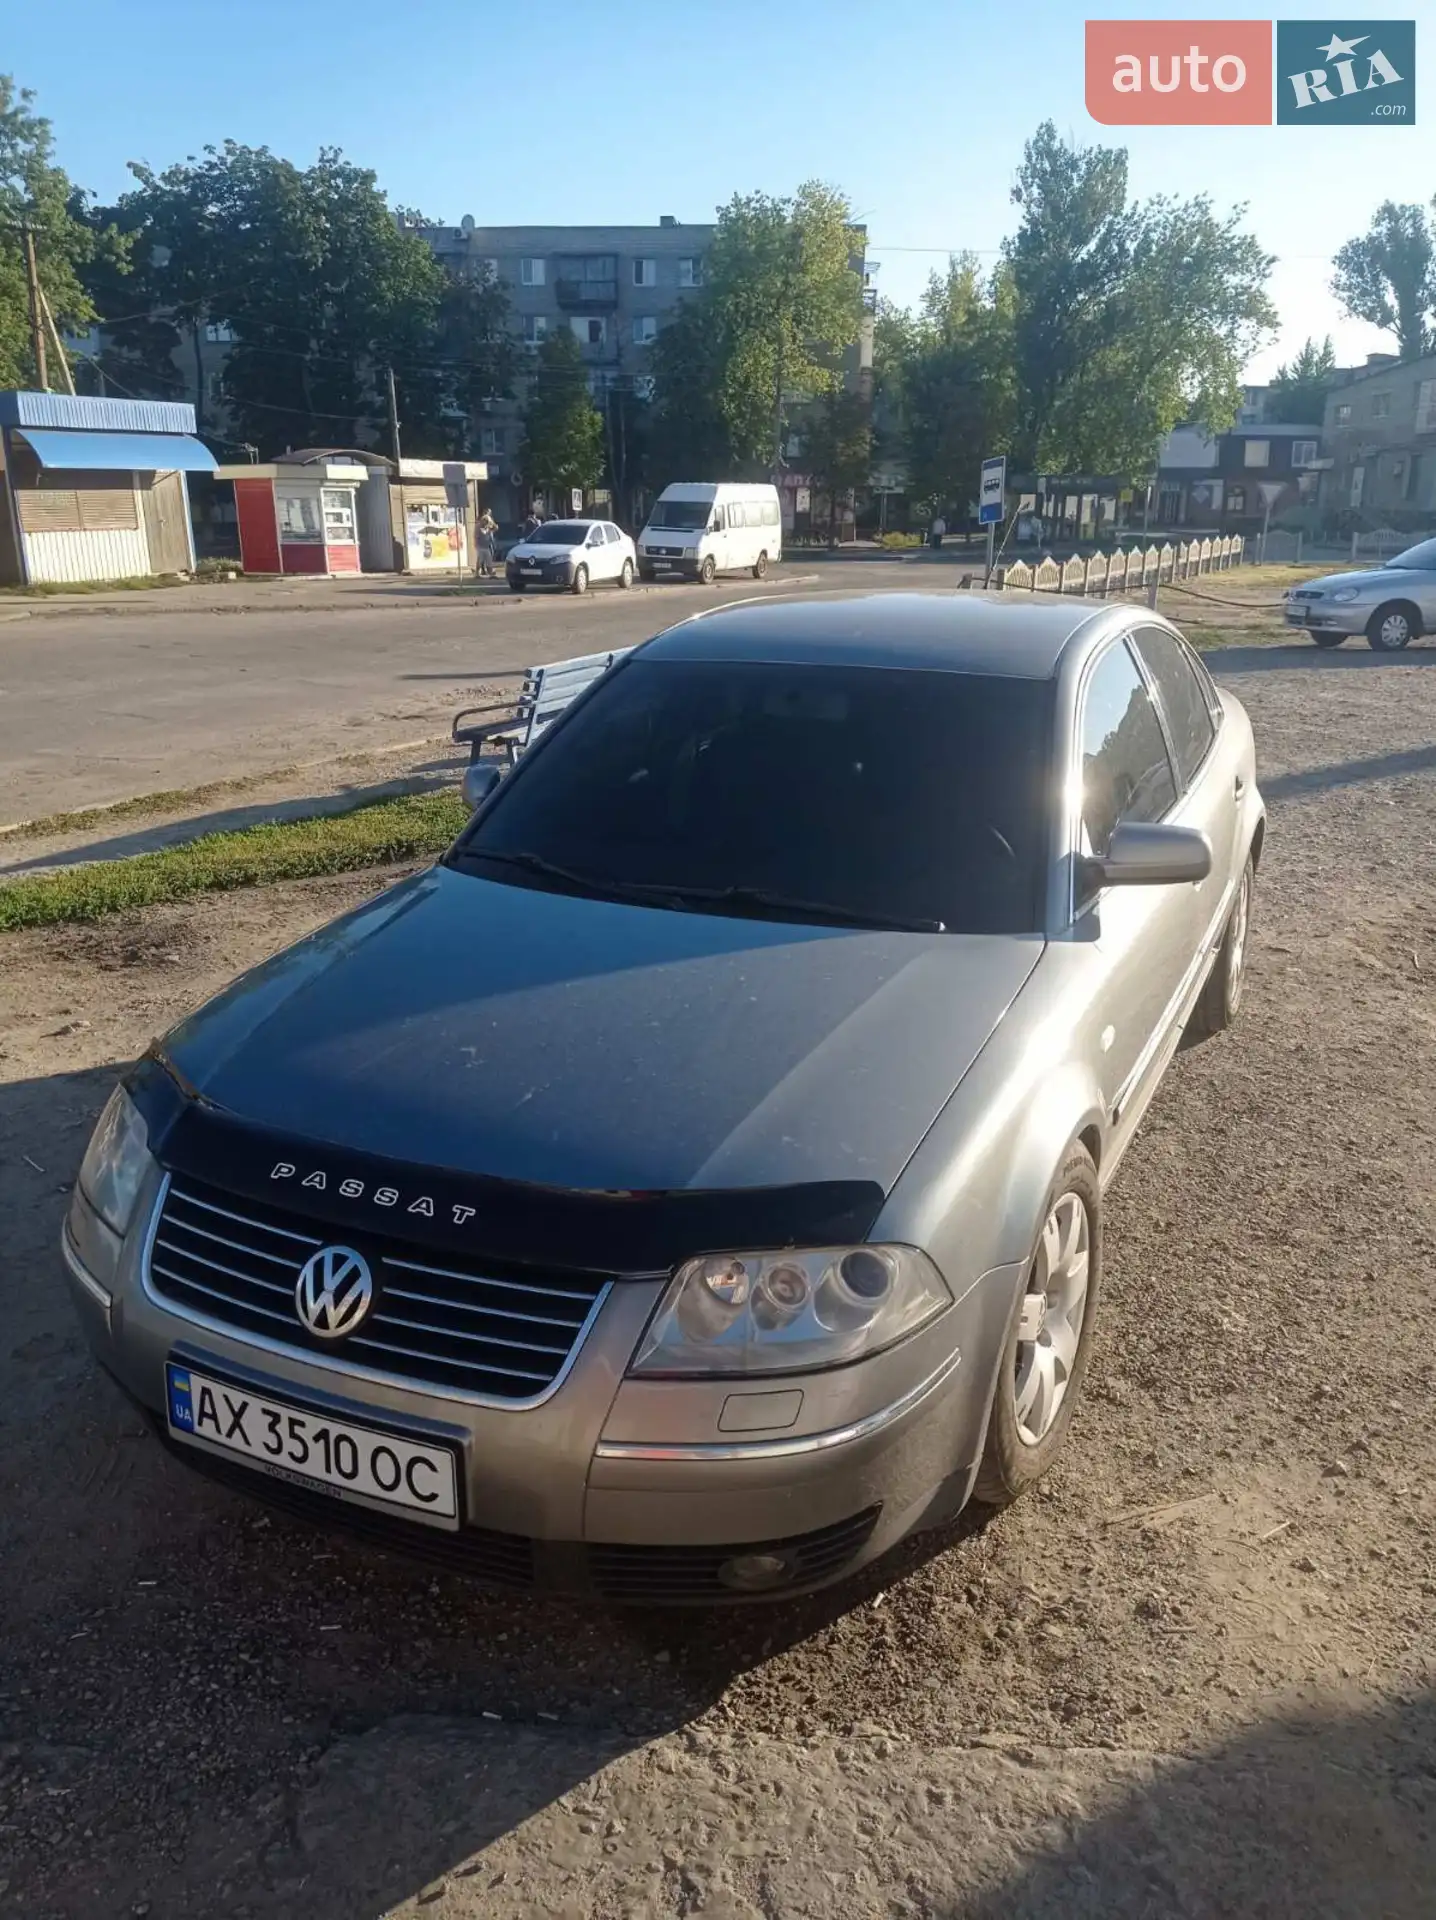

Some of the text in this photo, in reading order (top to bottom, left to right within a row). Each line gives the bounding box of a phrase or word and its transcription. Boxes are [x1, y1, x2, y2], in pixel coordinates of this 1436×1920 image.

[270, 1162, 477, 1225] PASSAT
[175, 1403, 192, 1422] UA
[197, 1386, 440, 1503] AX 3510 OC
